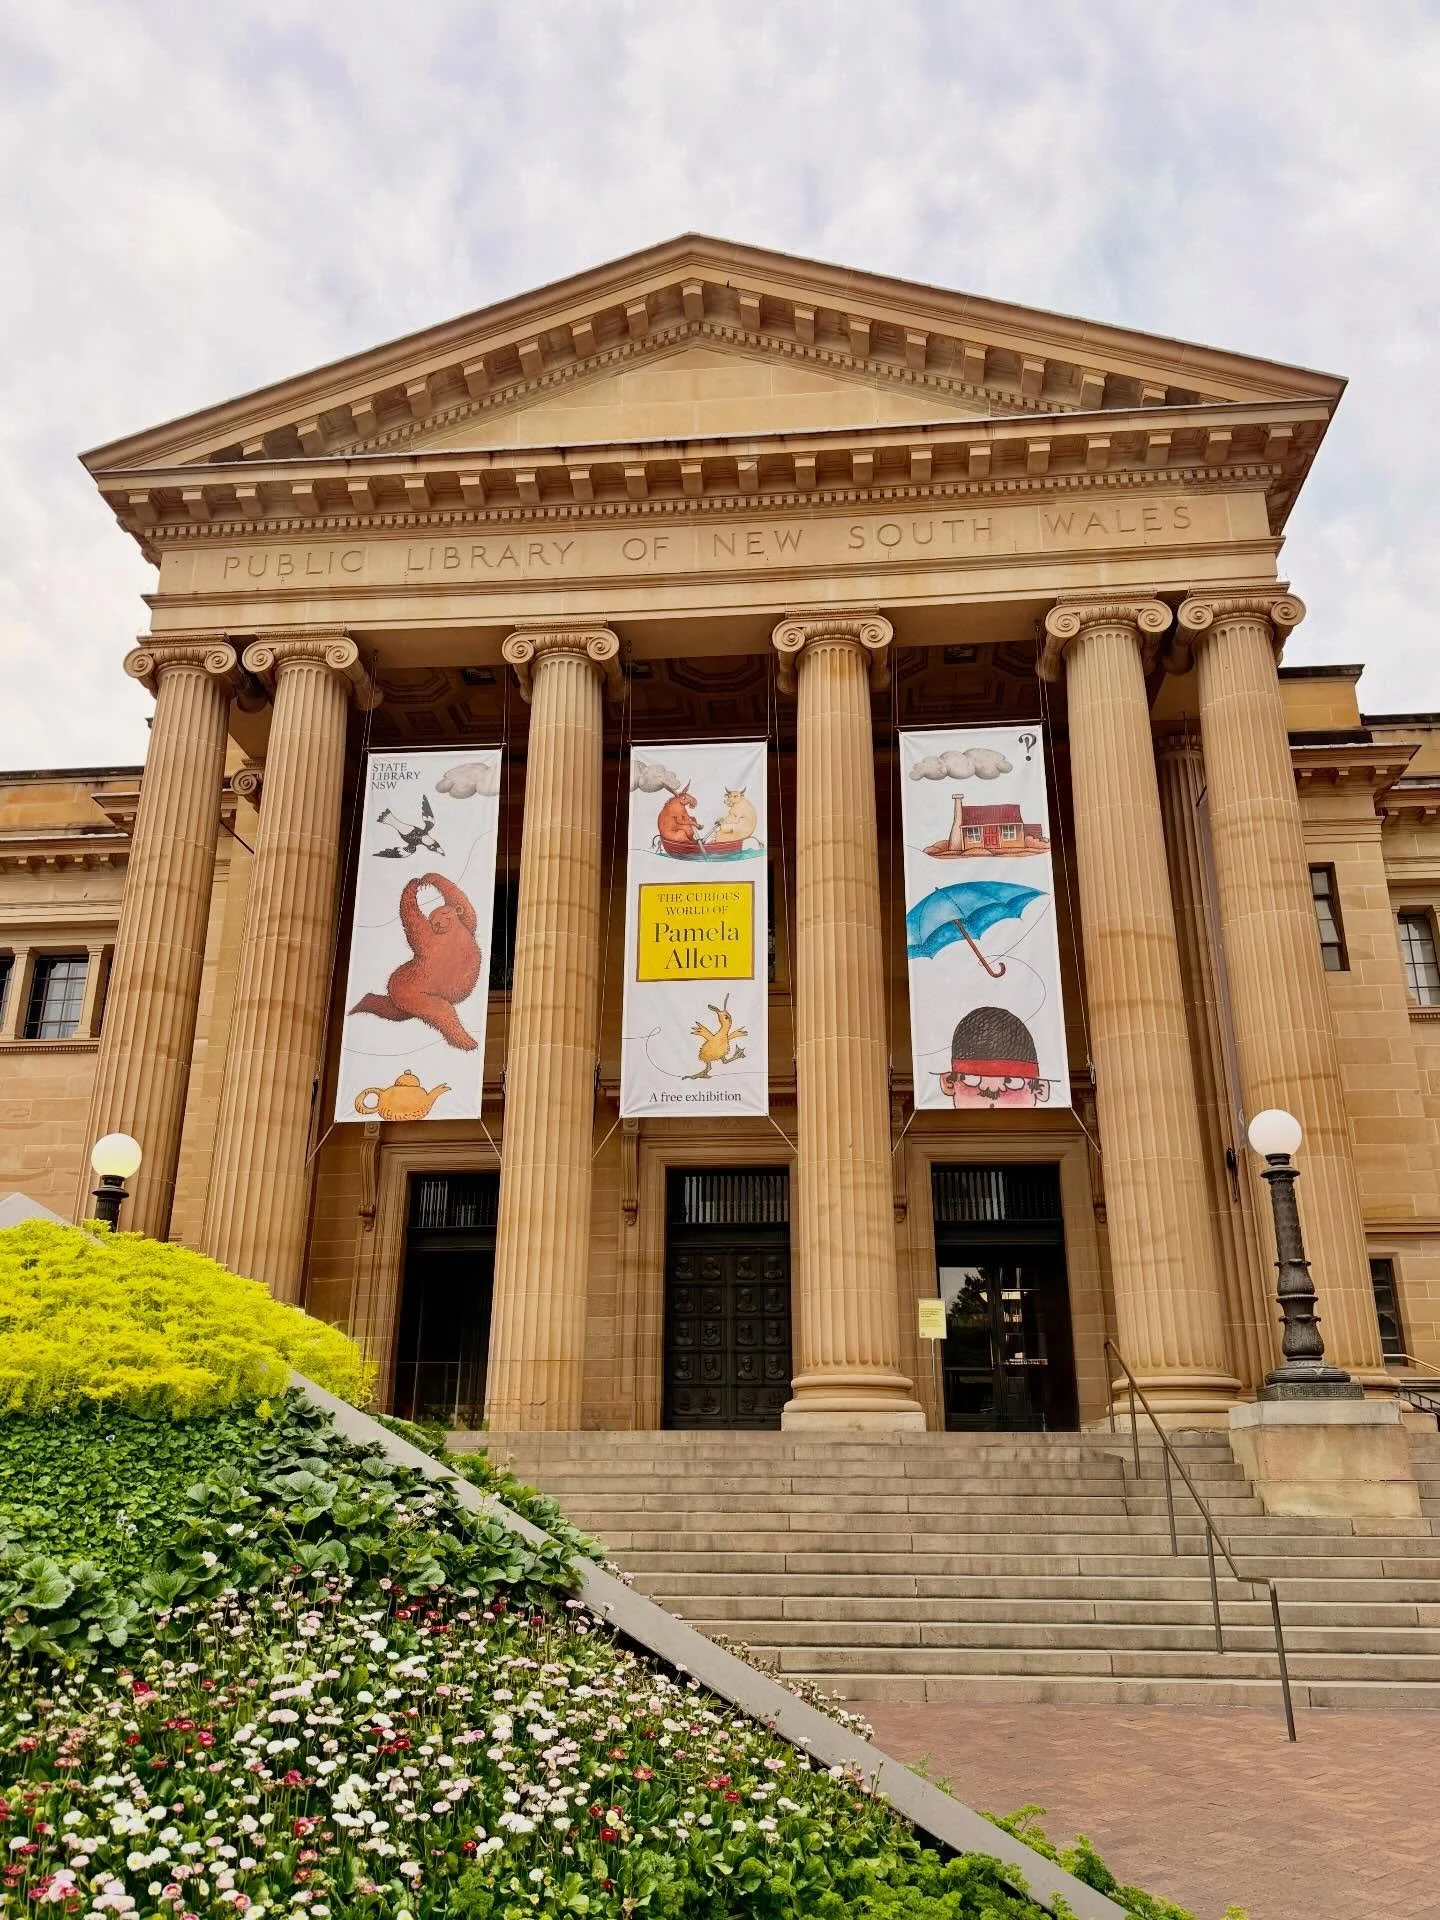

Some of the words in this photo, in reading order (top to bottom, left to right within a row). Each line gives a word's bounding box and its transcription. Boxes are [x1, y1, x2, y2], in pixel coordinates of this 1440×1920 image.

[224, 549, 363, 579] PUBLIC
[407, 541, 575, 571] LIBRARY
[622, 535, 669, 561] OF
[713, 529, 803, 557] NEW
[848, 517, 993, 550] SOUTH
[1044, 504, 1191, 536] WALES
[373, 763, 407, 772] STATE
[372, 771, 421, 780] LIBRARY
[371, 781, 396, 790] NSW
[658, 892, 682, 903] THE
[687, 891, 740, 902] CURIOUS
[666, 905, 708, 915] WORLD
[711, 905, 728, 915] OF
[654, 922, 740, 942] Pamela
[664, 948, 728, 969] Allen
[649, 1093, 658, 1103] A
[660, 1091, 683, 1102] free
[685, 1090, 742, 1102] exhibition
